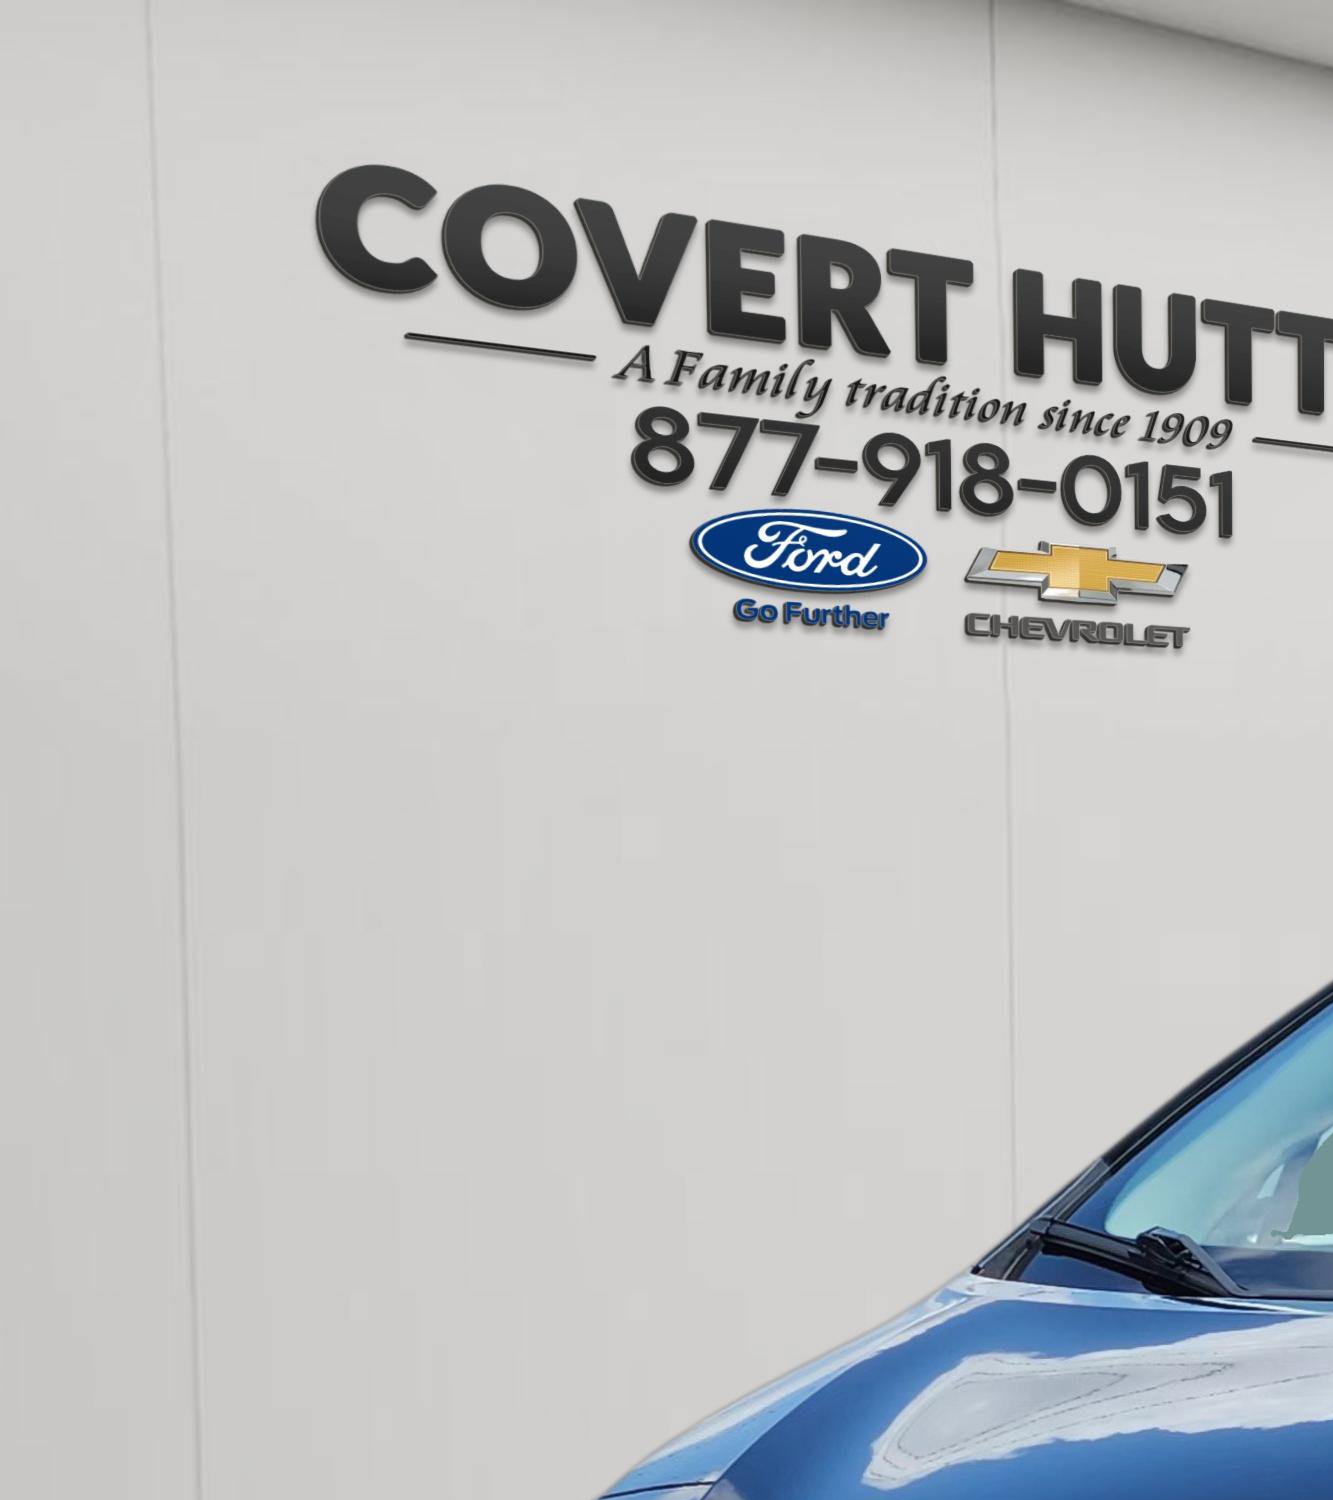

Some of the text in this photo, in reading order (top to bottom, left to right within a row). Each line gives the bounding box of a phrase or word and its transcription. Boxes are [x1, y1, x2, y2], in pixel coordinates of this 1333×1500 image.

[316, 164, 974, 367] COVERT
[664, 349, 833, 420] Family
[845, 375, 1027, 428] tradition
[1036, 399, 1132, 439] since
[1138, 410, 1234, 451] 1909
[630, 406, 1233, 540] 877-918-0151
[743, 520, 882, 578] Ford
[733, 598, 890, 630] Go Further
[965, 612, 1191, 650] CHEVROLET
